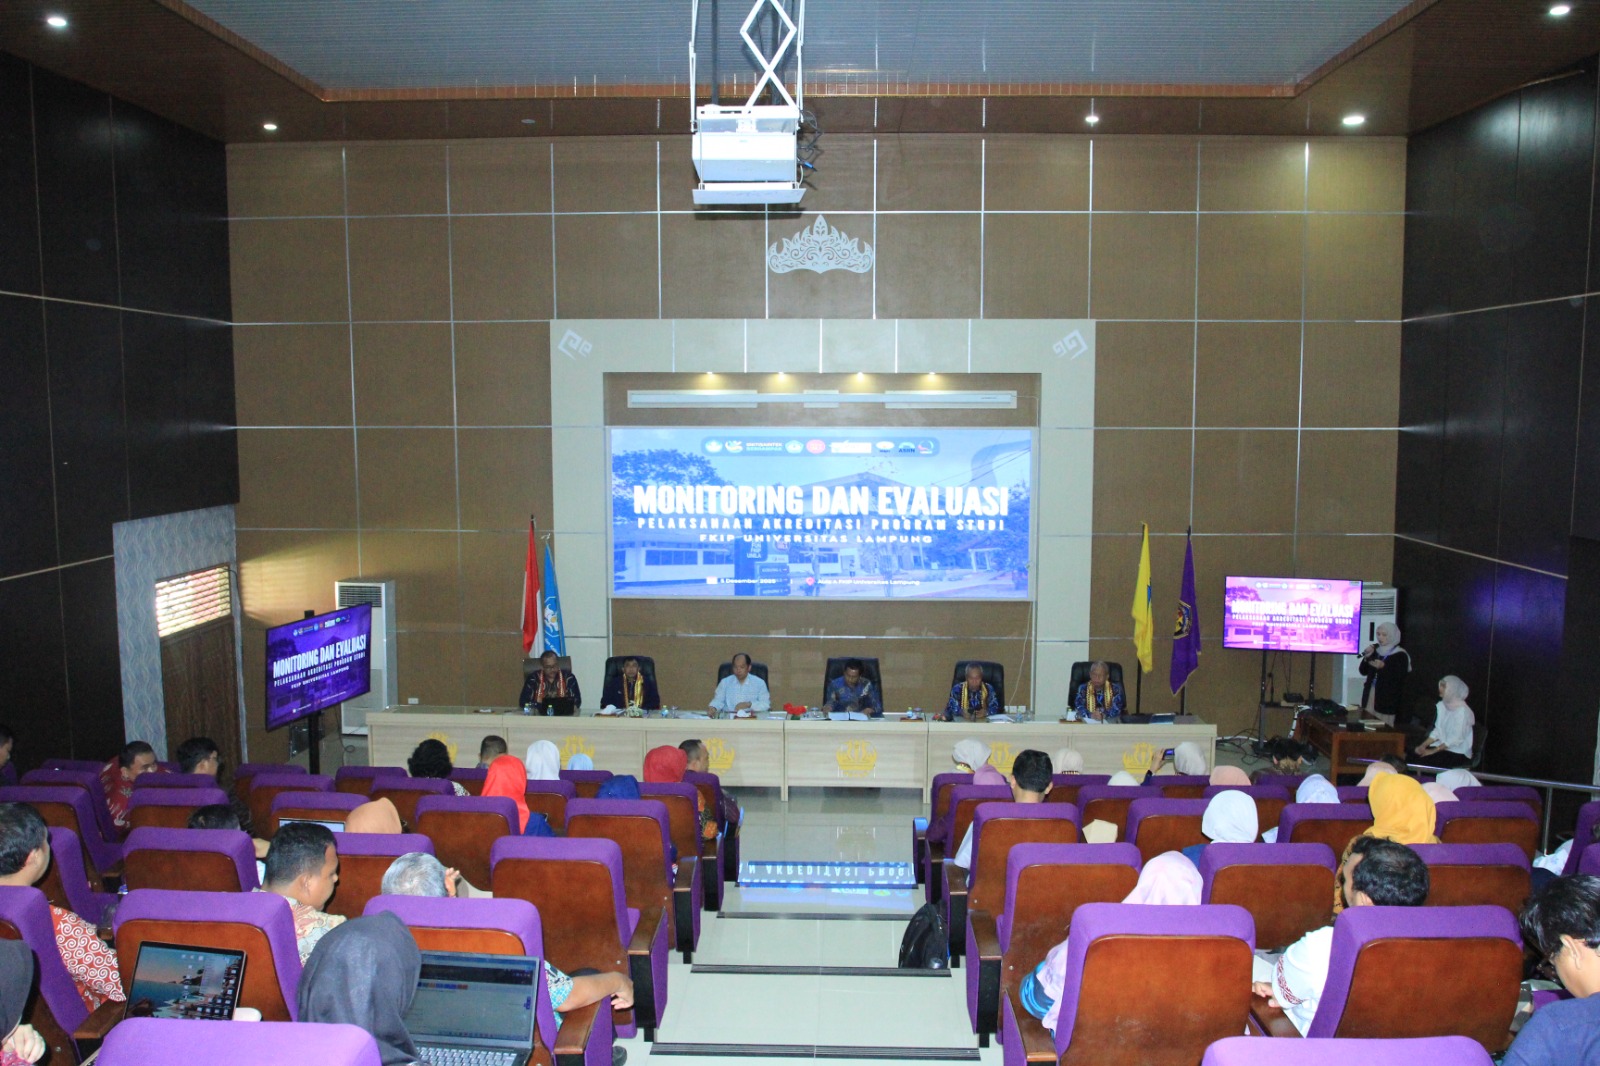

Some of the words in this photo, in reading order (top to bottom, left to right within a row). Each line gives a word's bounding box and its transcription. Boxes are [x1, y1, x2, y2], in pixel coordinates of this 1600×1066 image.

[633, 485, 804, 515] MONITORING
[812, 486, 869, 515] DAN
[878, 486, 1009, 516] EVALUASI
[638, 518, 753, 529] PELAKSANAAN
[762, 518, 861, 530] AKREDITASI
[871, 518, 947, 531] PROGRAM
[956, 520, 1005, 531] STUDI
[700, 534, 735, 542] FKIP
[743, 534, 848, 543] UNIVERSITAS
[856, 535, 933, 544] LAMPUNG
[1231, 600, 1288, 615] MONITORING
[1289, 602, 1308, 616] DAN
[1310, 602, 1354, 618] EVALUASI
[273, 648, 319, 678] MONITORING
[320, 644, 335, 664] DAN
[336, 634, 366, 658] EVALUASI
